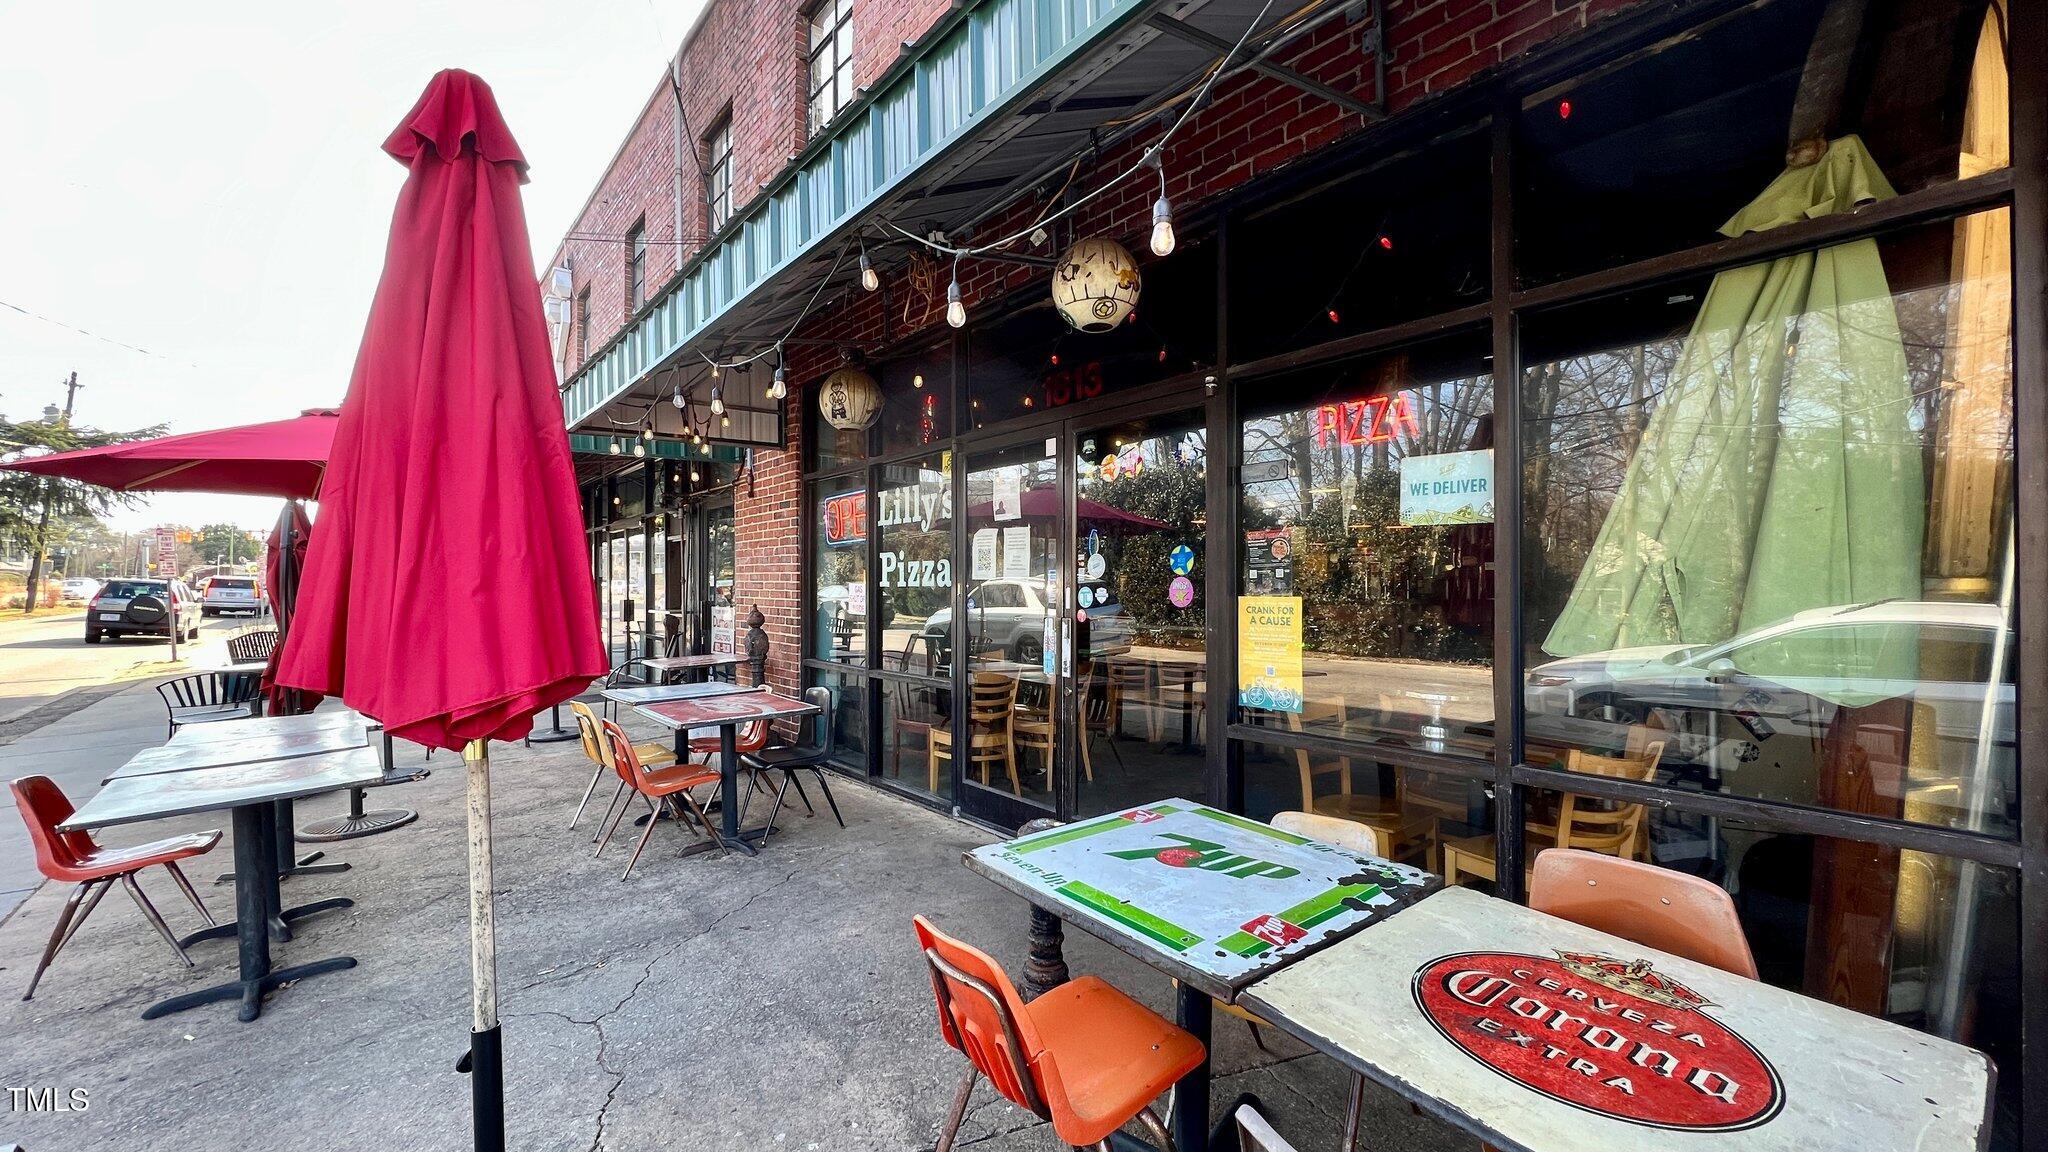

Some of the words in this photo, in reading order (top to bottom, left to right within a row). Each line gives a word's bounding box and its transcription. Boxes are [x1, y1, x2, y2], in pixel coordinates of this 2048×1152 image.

[1318, 390, 1420, 449] PIZZA
[877, 484, 951, 532] Lilly's
[1410, 482, 1429, 497] WE
[1433, 478, 1487, 496] DELIVER
[879, 550, 951, 588] Pizza
[1245, 605, 1275, 615] CRANK
[1277, 606, 1295, 615] FOR
[1249, 616, 1257, 625] A
[1259, 616, 1291, 626] CAUSE
[1511, 968, 1706, 1048] CERVEZA
[1441, 970, 1741, 1104] Corona
[1475, 1017, 1635, 1095] EXTRA
